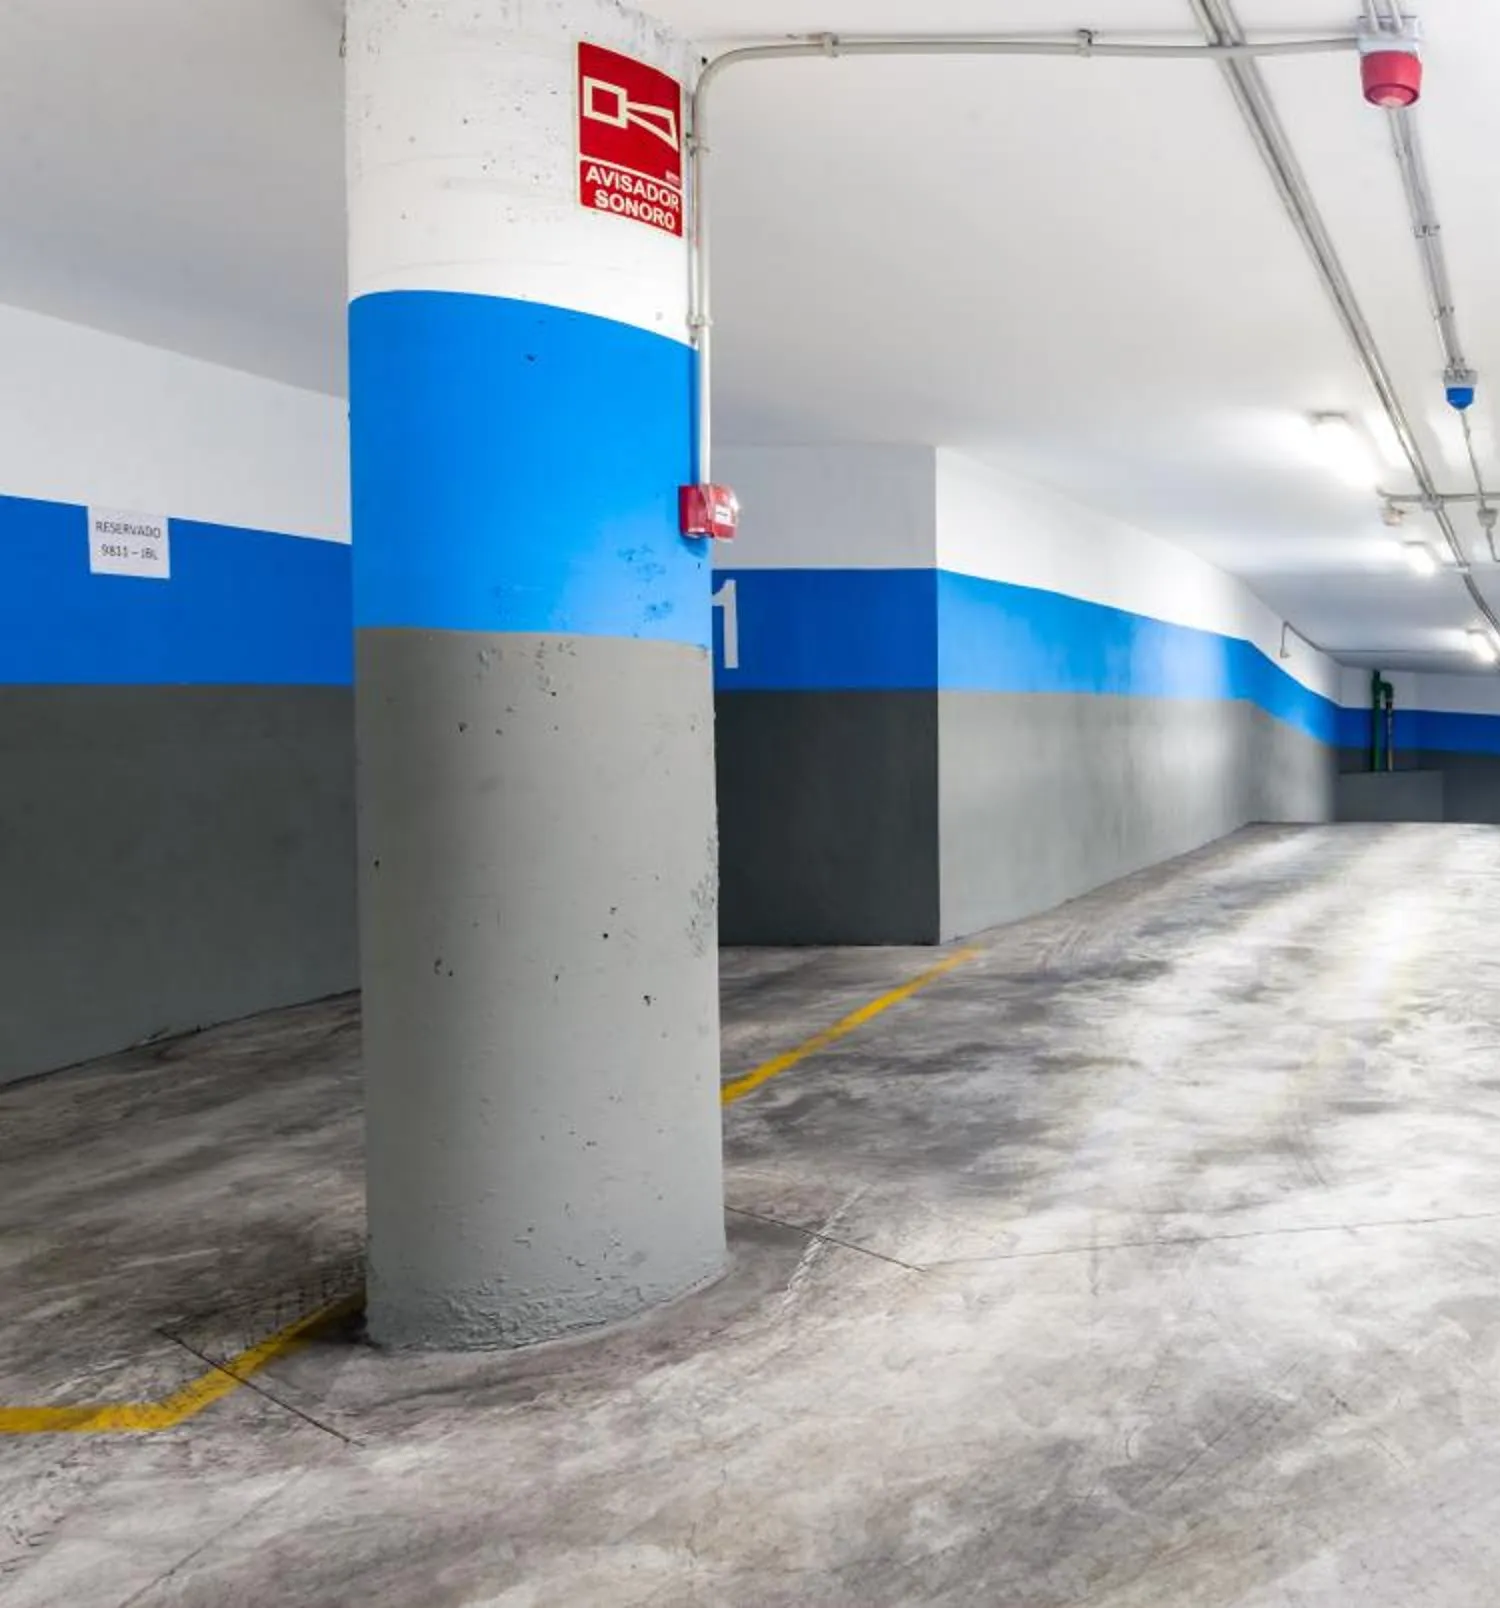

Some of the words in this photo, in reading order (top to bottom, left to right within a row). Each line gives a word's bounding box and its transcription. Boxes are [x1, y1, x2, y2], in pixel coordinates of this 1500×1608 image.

[585, 166, 679, 212] AVISADOR
[595, 189, 675, 229] SONORO
[95, 521, 161, 539] RESERVADO
